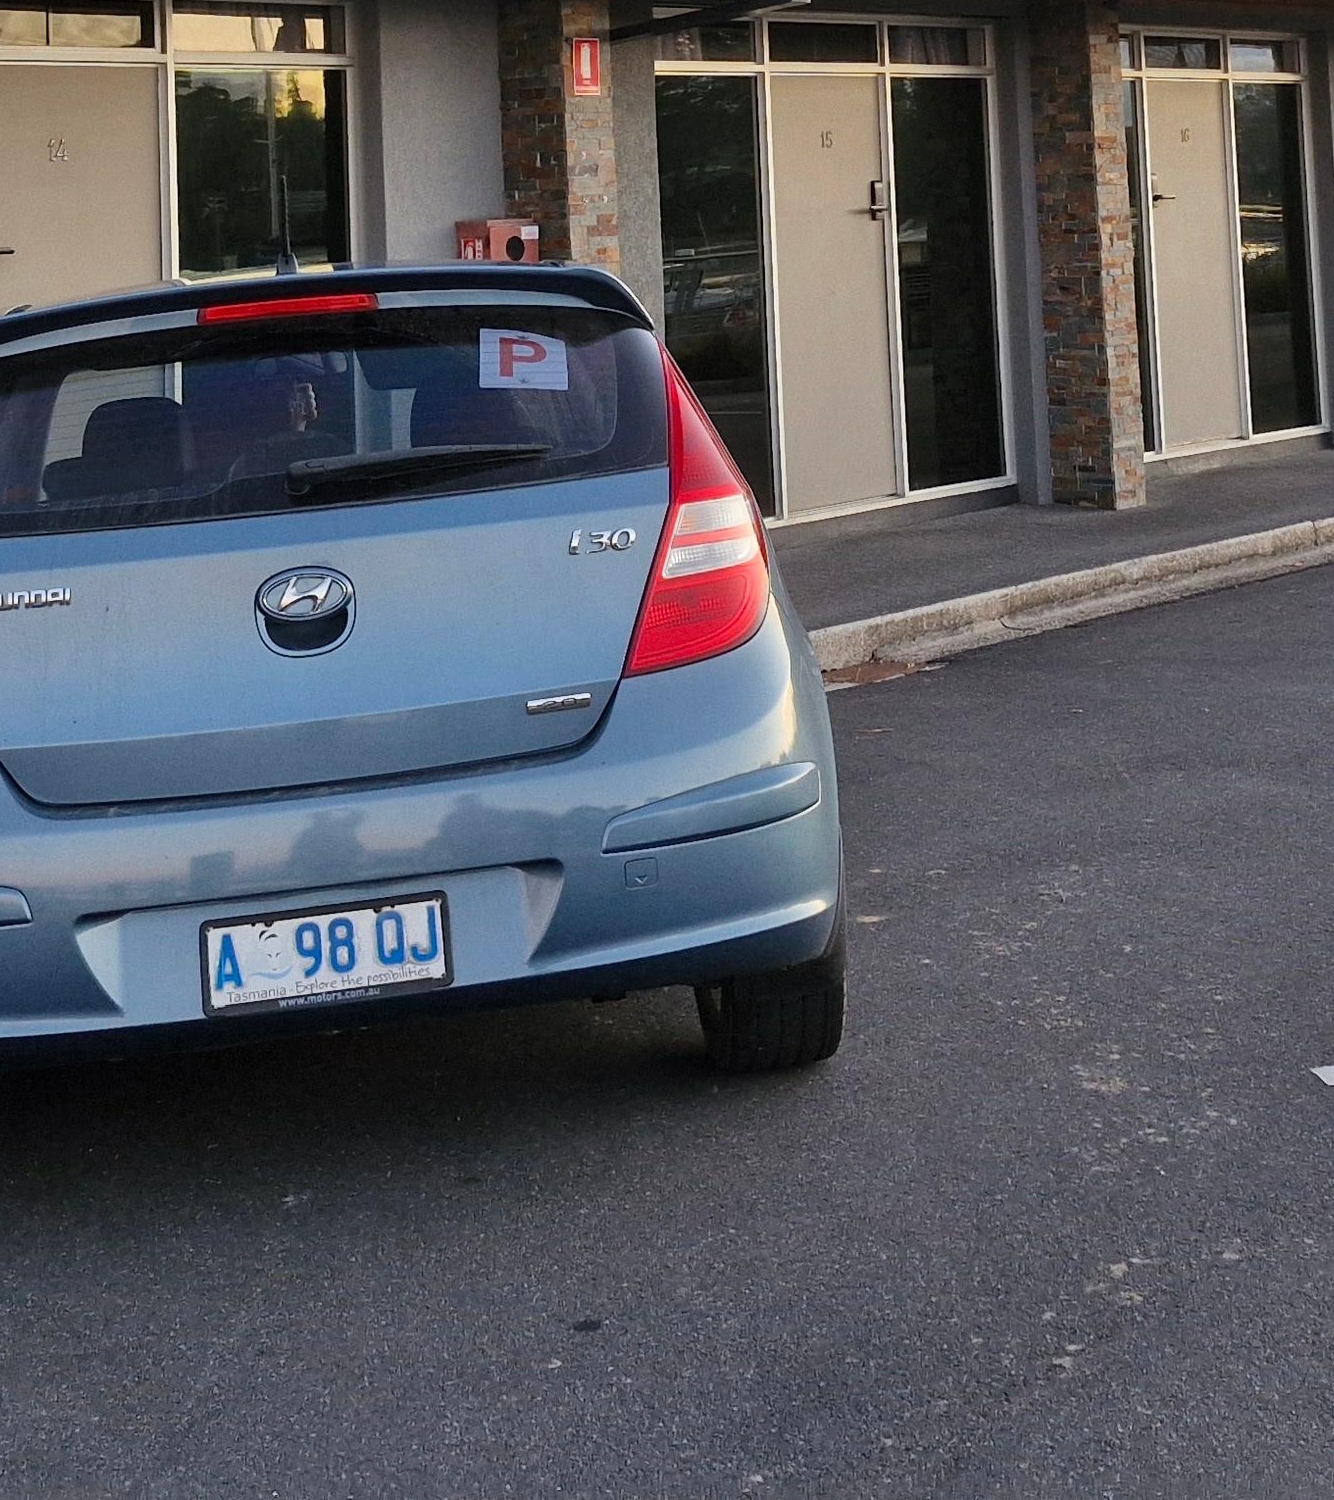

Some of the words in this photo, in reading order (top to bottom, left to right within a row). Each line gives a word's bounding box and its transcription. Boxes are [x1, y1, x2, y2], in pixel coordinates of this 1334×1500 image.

[47, 138, 69, 162] 14
[821, 131, 833, 148] 15
[498, 337, 547, 377] P
[215, 934, 244, 990] A
[295, 918, 356, 978] 98
[376, 905, 439, 965] QJ
[227, 985, 287, 1002] Tasmania
[295, 978, 338, 995] Explore
[341, 975, 364, 987] the
[366, 965, 431, 987] possibilities
[278, 986, 381, 1008] www.motors.com.au
